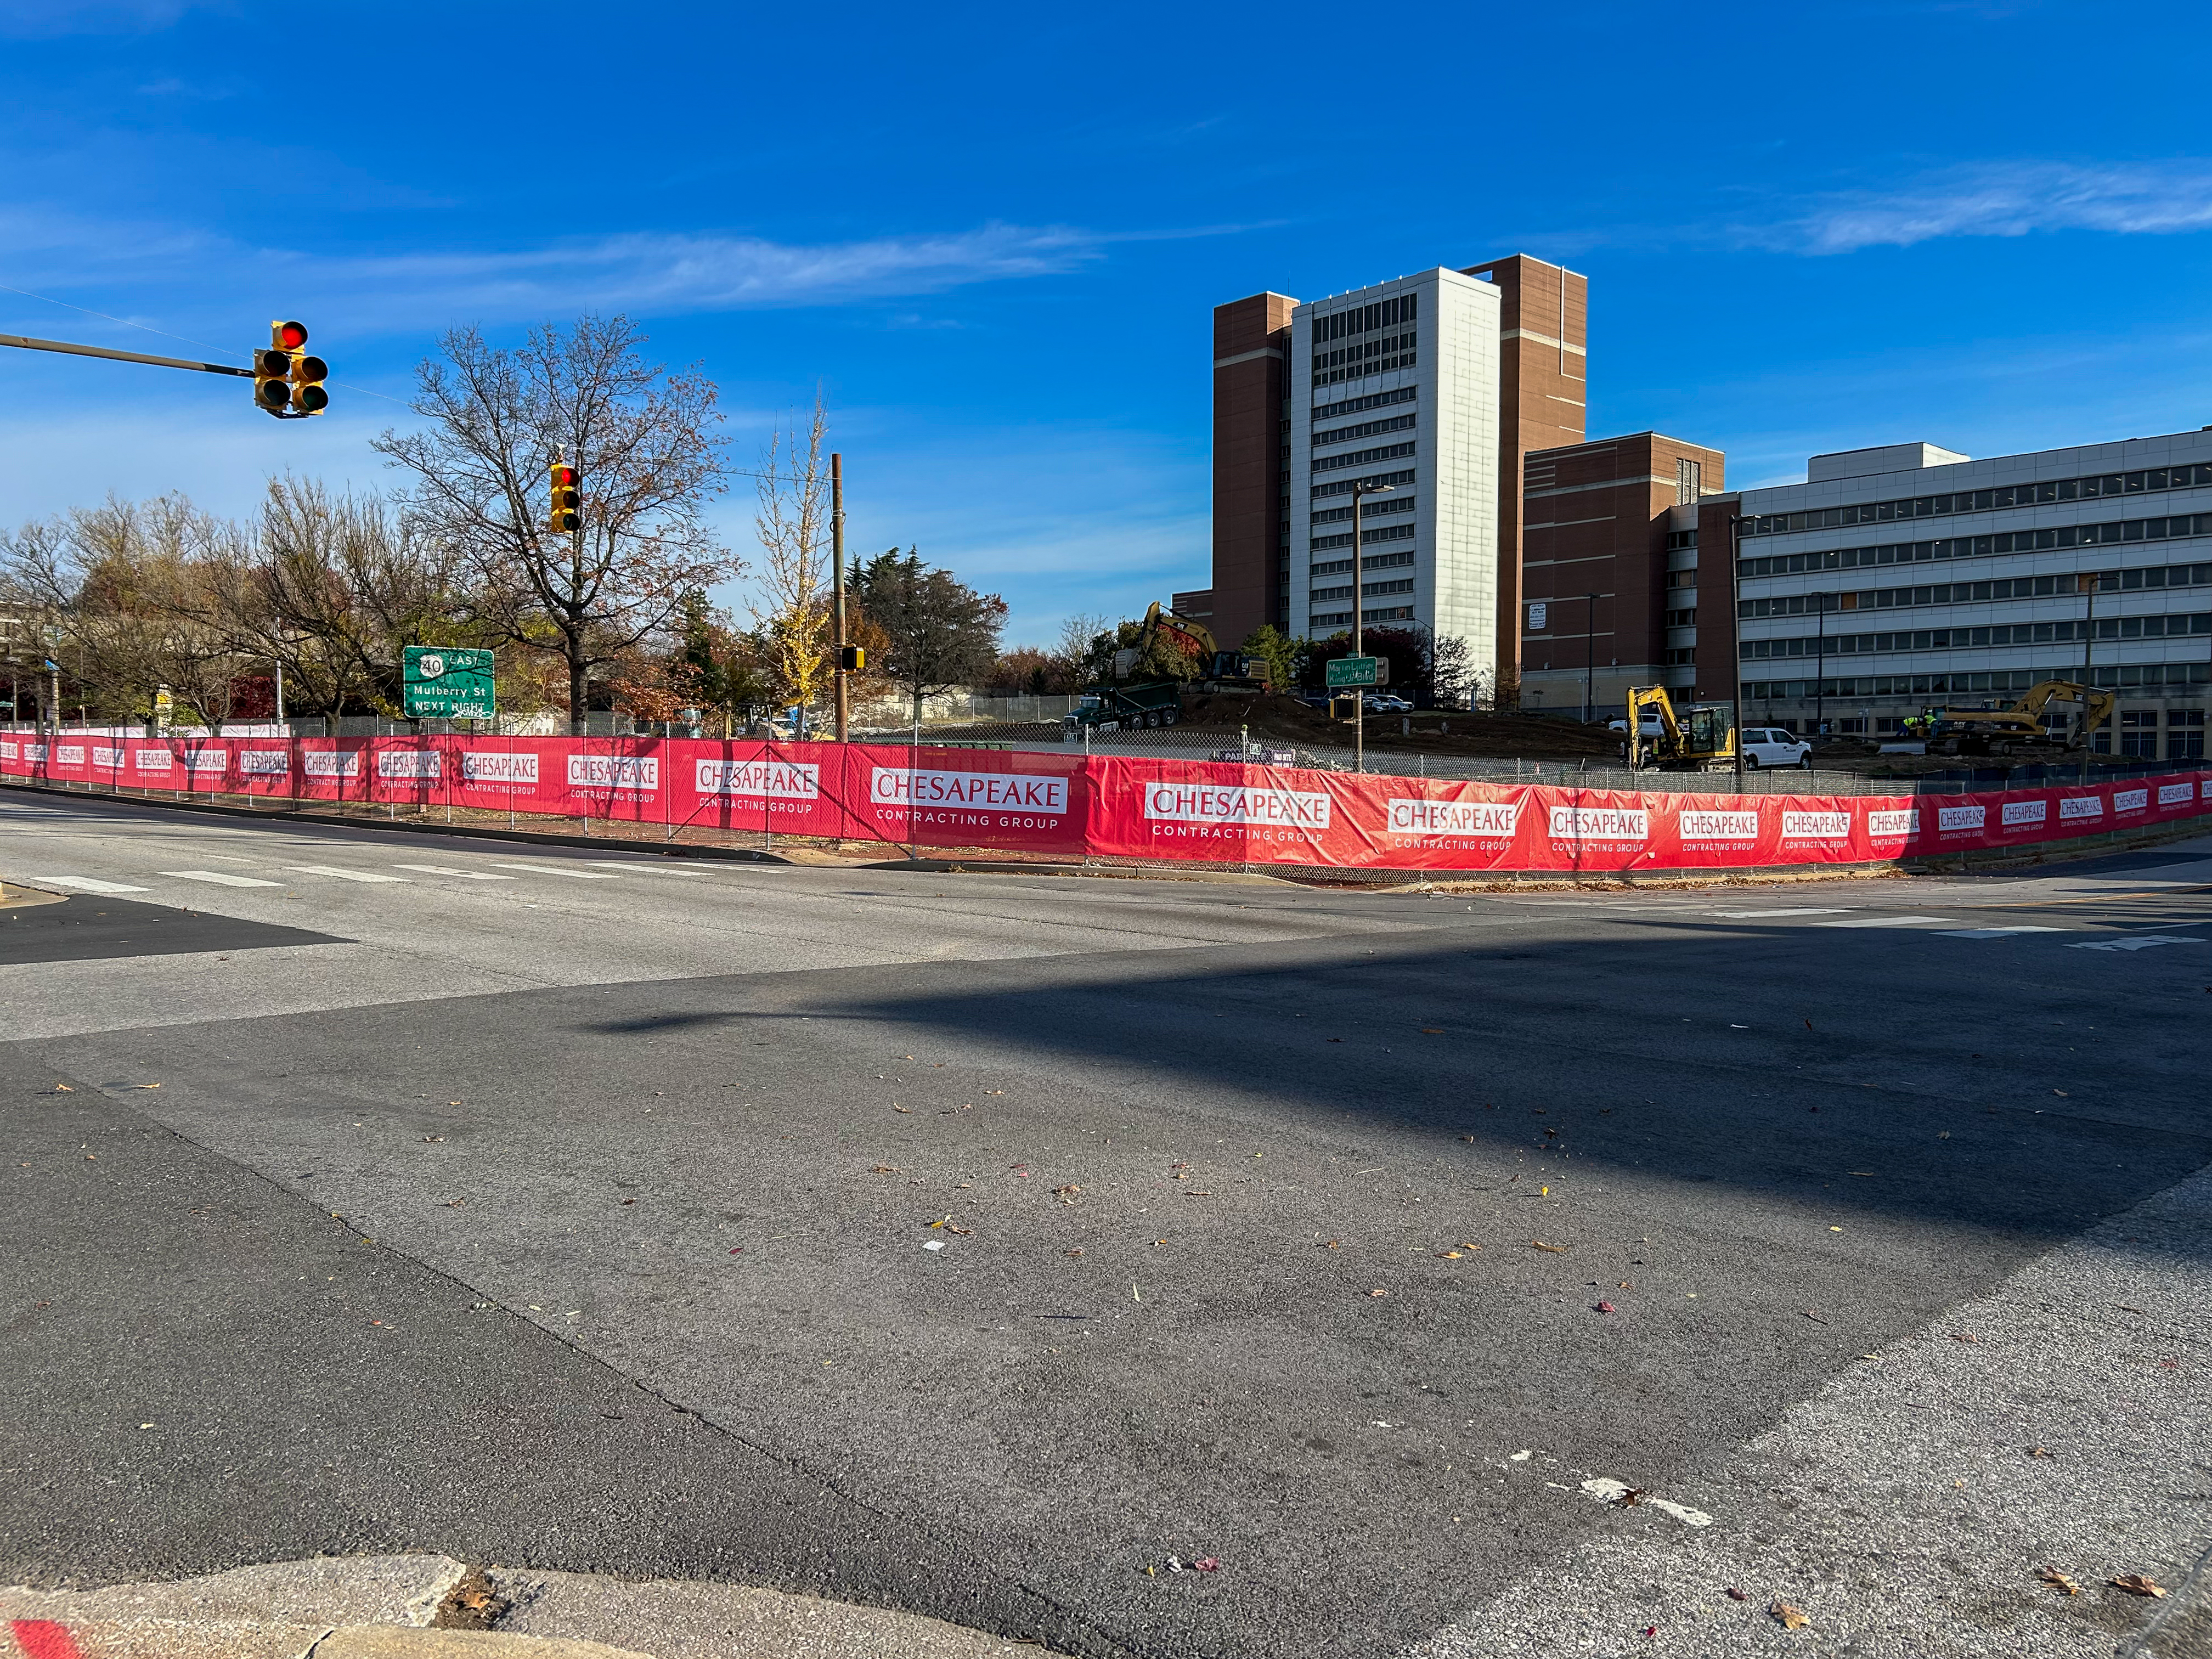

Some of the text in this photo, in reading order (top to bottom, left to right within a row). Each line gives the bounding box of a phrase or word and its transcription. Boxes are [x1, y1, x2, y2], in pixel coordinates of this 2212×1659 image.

[422, 661, 441, 673] 40
[450, 656, 478, 665] EAST
[1329, 664, 1351, 672] Martin
[1329, 675, 1345, 684] King
[1357, 672, 1373, 681] Blvd
[414, 686, 486, 697] Mulberry St
[415, 702, 484, 712] NEXT RIGHT
[137, 753, 171, 766] CHESAPEAKE
[242, 755, 286, 769] CHESAPEAKE
[307, 755, 356, 771] CHESAPEAKE
[381, 755, 438, 772] CHESAPEAKE
[571, 760, 654, 783] CHESAPEAKE
[701, 766, 812, 792] CHESAPEAKE
[466, 784, 536, 795] CONTRACTING GROUP
[571, 790, 654, 803] CONTRACTING GROUP
[878, 774, 1060, 807] CHESAPEAKE
[700, 798, 812, 814] CONTRACTING GROUP
[1153, 790, 1324, 822] CHESAPEAKE
[2062, 800, 2101, 815] CHESAPEAKE
[2116, 793, 2146, 808] CHESAPEAKE
[877, 810, 1058, 829] CONTRACTING GROUP
[1395, 805, 1512, 831] CHESAPEAKE
[1941, 810, 1984, 826] CHESAPEAKE
[2004, 804, 2044, 821] CHESAPEAKE
[1554, 812, 1644, 834] CHESAPEAKE
[1683, 816, 1755, 834] CHESAPEAKE
[1786, 816, 1847, 833] CHESAPEAKE
[1871, 814, 1918, 831] CHESAPEAKE
[2004, 825, 2030, 834] CONTRACTING
[1153, 826, 1323, 843] CONTRACTING GROUP
[1871, 838, 1905, 846] CONTRACTING
[1940, 832, 1971, 840] CONTRACTING
[1396, 839, 1511, 850] CONTRACTING GROUP
[1553, 843, 1644, 852] CONTRACTING GROUP
[1683, 843, 1729, 851] CONTRACTING
